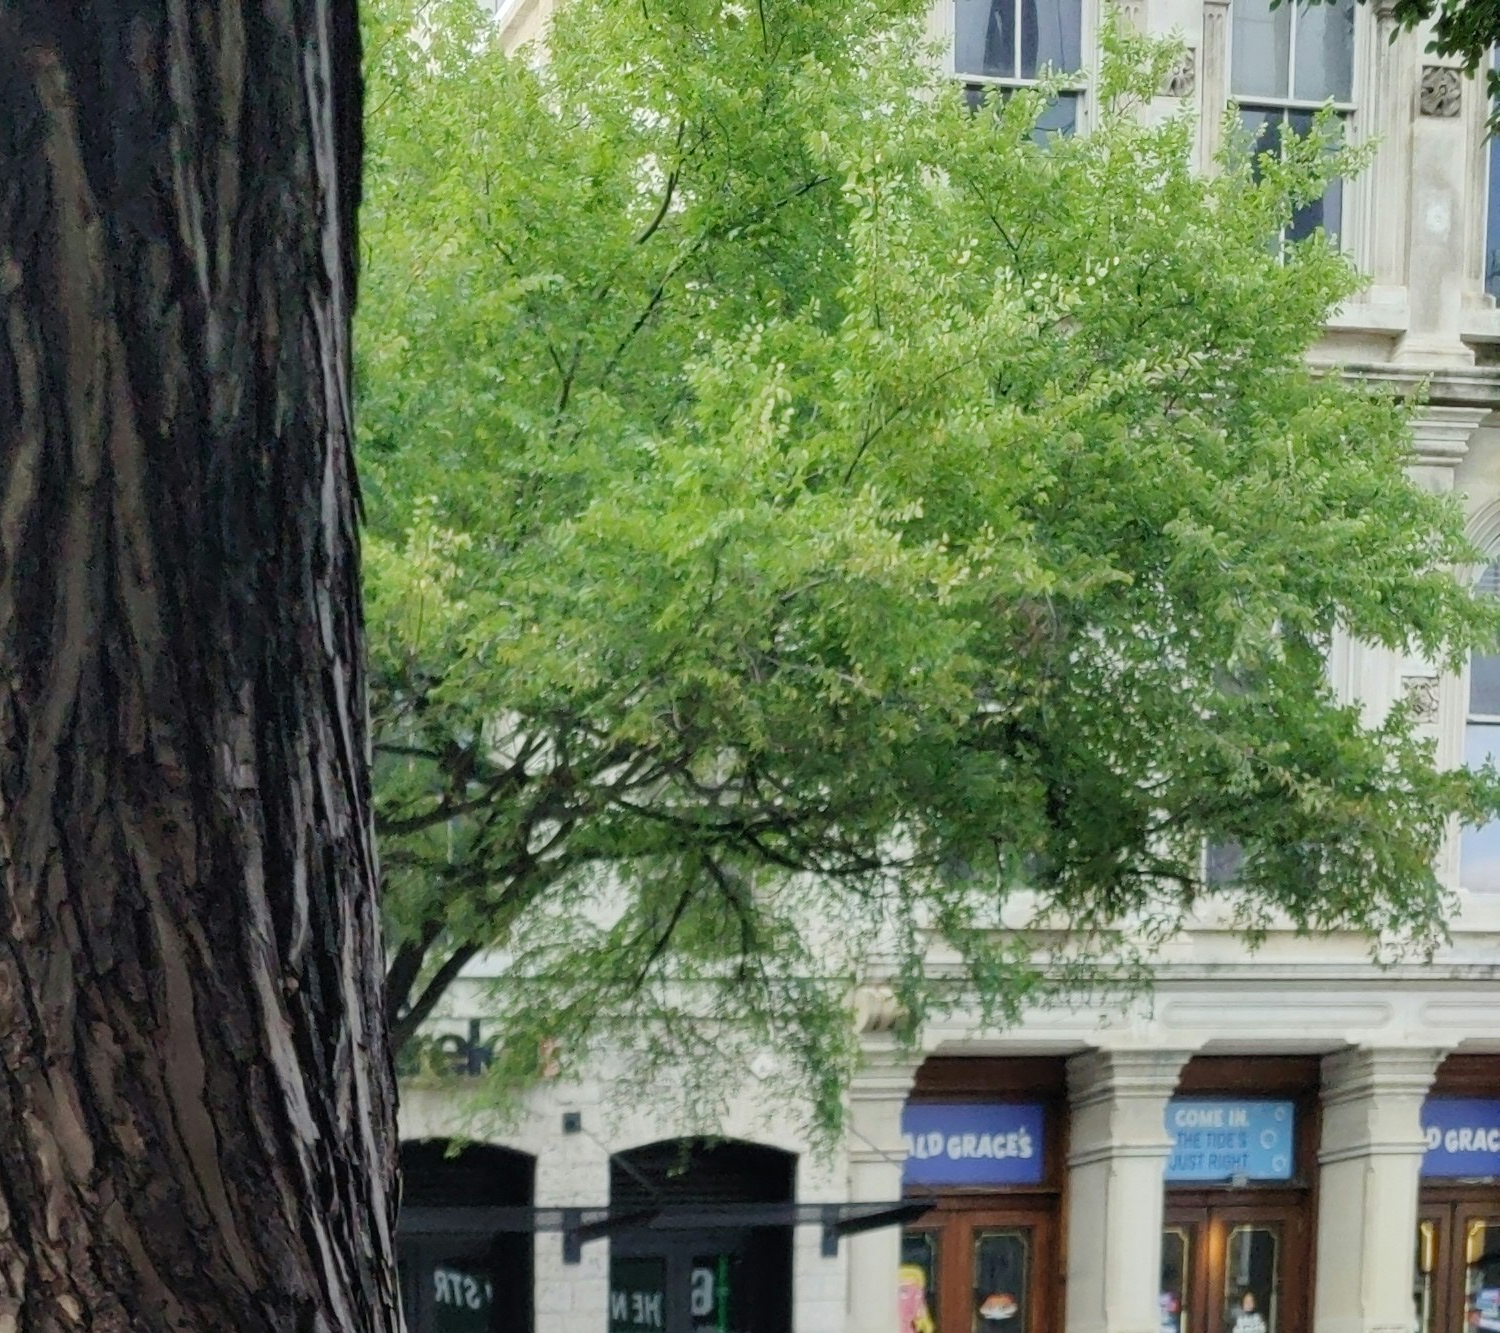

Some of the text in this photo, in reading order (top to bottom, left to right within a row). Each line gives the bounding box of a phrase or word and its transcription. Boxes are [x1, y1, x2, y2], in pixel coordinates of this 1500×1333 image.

[1175, 1107, 1224, 1128] COME
[946, 1124, 1034, 1160] GRACE'S
[1177, 1130, 1201, 1149] THE
[1169, 1152, 1250, 1171] JUST RIGHT
